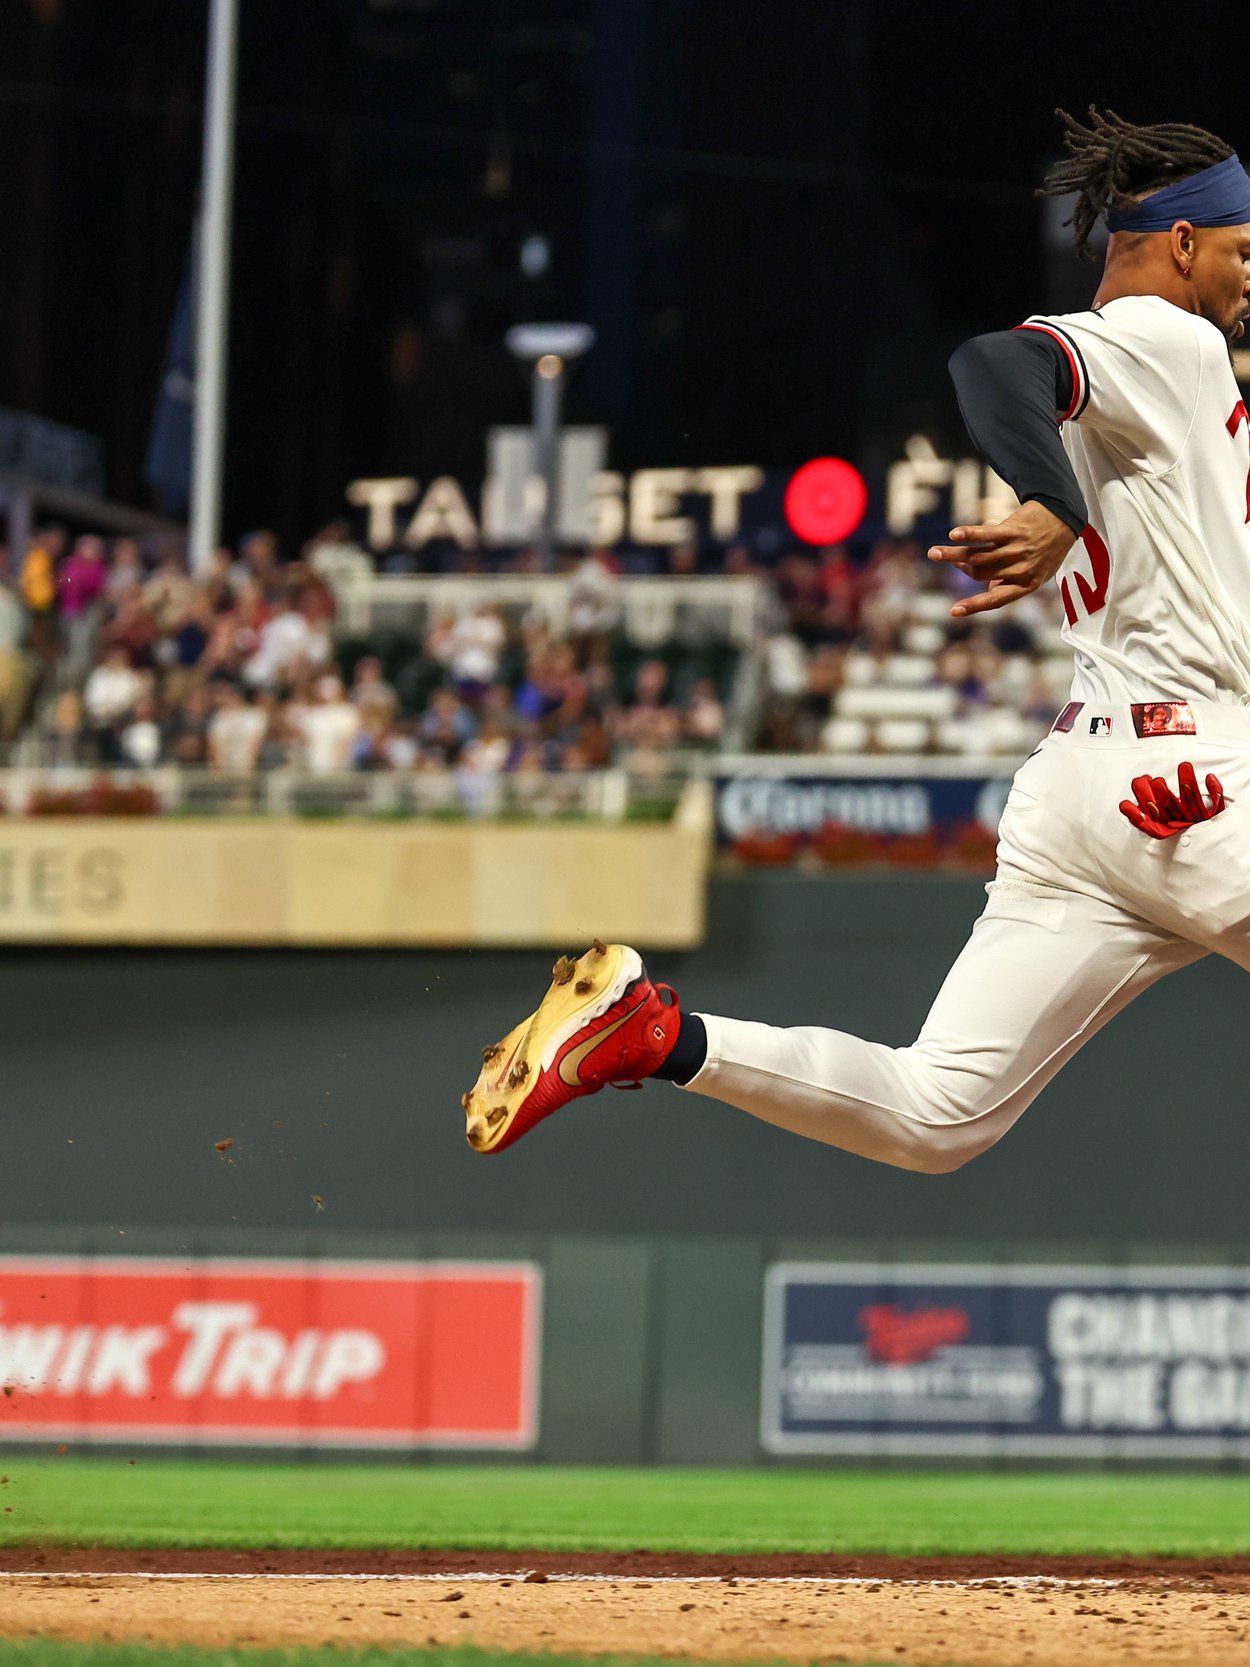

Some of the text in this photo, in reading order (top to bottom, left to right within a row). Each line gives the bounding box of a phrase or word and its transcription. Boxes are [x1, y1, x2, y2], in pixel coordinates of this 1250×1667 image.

[721, 772, 931, 840] Corona
[171, 1301, 387, 1400] TRIP
[1058, 1363, 1166, 1430] THE
